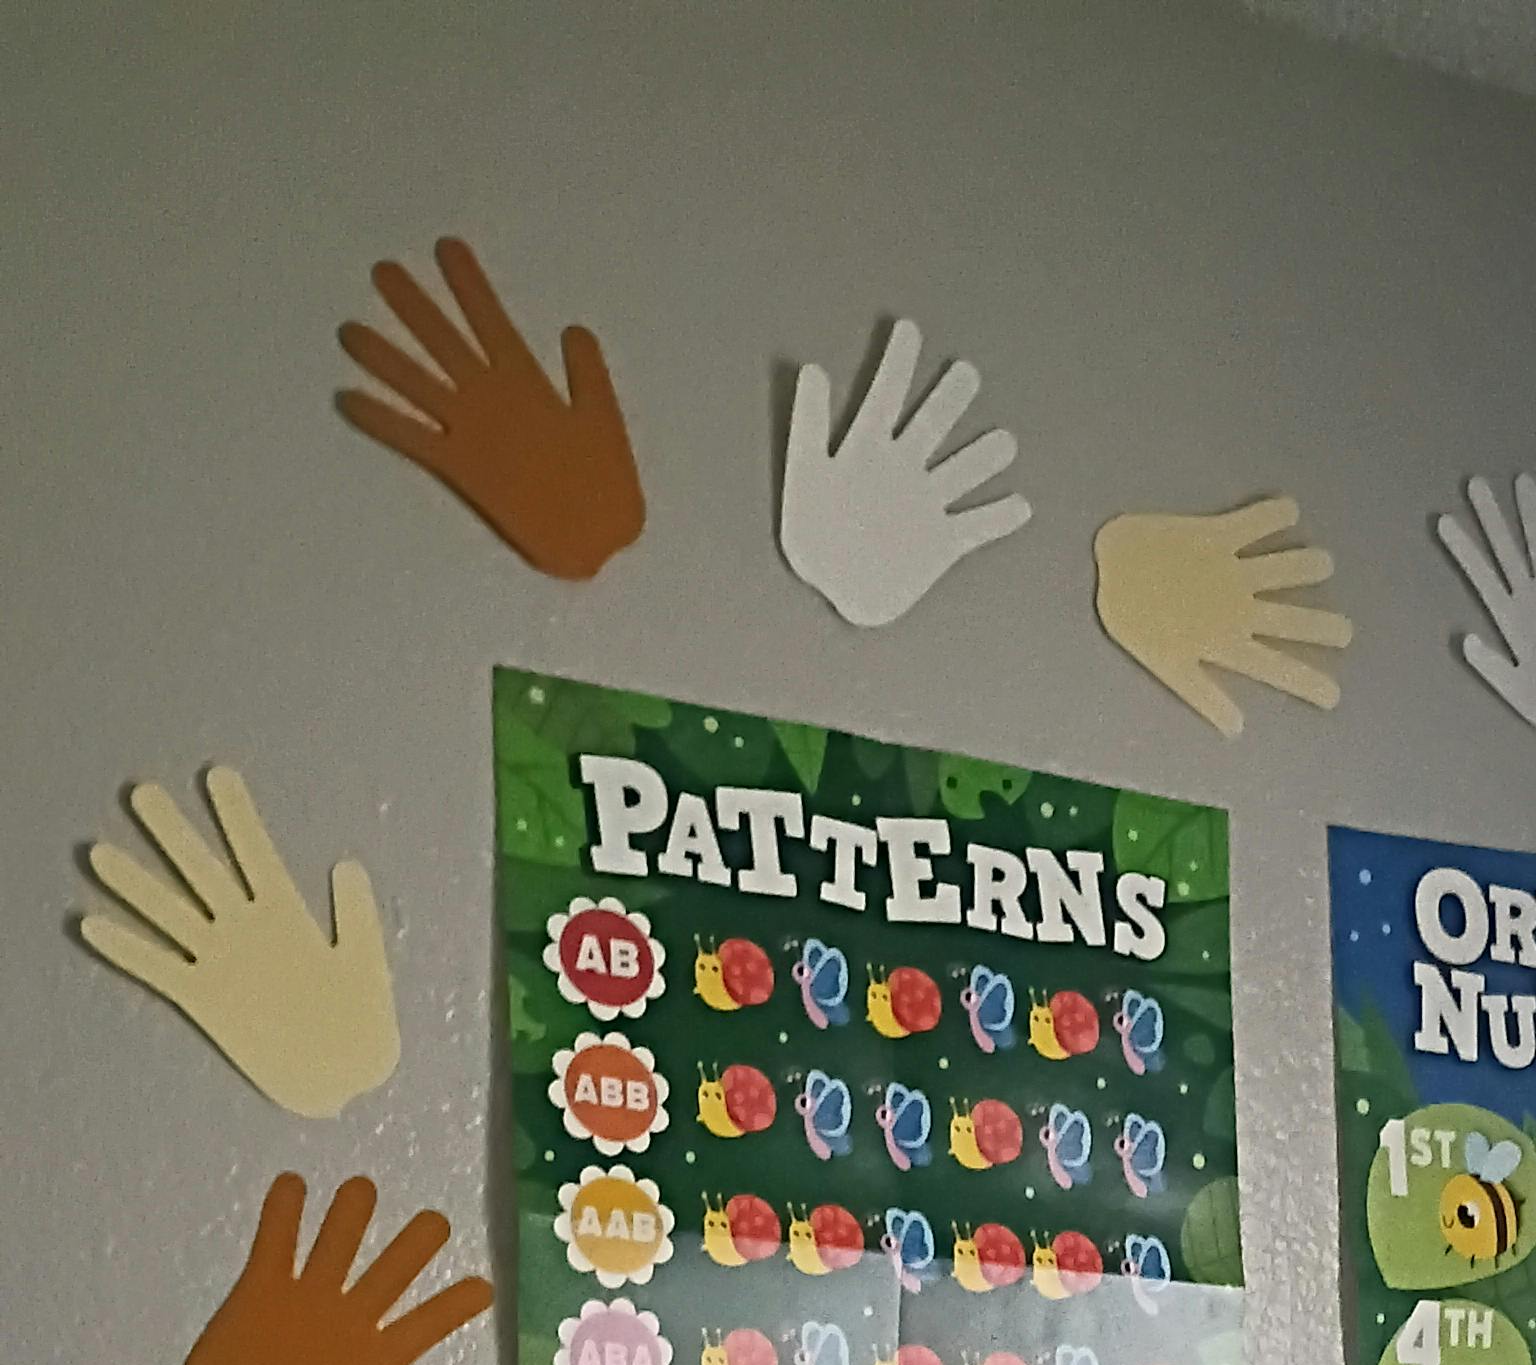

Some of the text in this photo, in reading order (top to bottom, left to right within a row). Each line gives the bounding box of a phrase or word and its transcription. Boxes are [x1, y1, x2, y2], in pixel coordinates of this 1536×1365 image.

[579, 753, 1167, 961] PATTERNS
[576, 935, 640, 979] AB
[574, 1075, 650, 1113] ABB
[1379, 1117, 1457, 1198] 1ST
[577, 1205, 657, 1244] AAB
